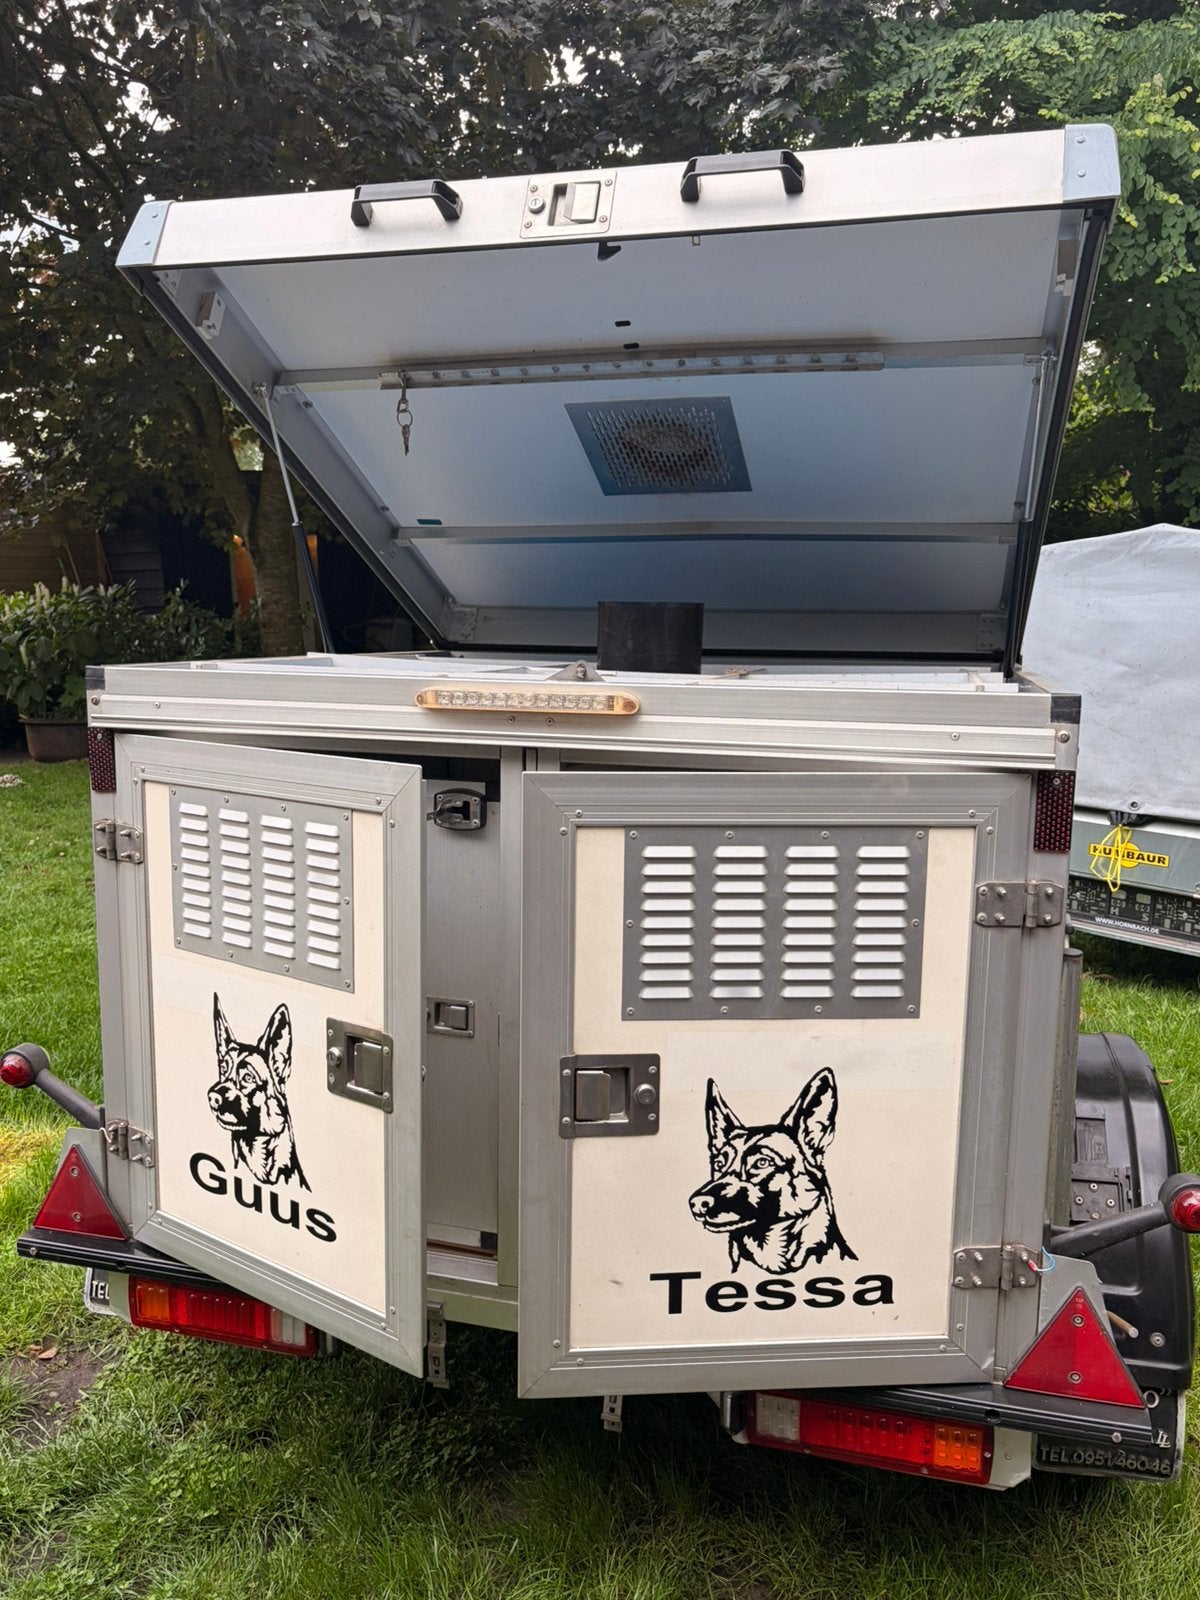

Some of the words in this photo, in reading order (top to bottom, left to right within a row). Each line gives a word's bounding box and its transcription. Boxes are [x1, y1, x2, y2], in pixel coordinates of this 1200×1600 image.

[1095, 916, 1159, 934] WWW.HORNBACH.DE
[189, 1152, 337, 1242] Guus
[649, 1271, 895, 1315] Tessa
